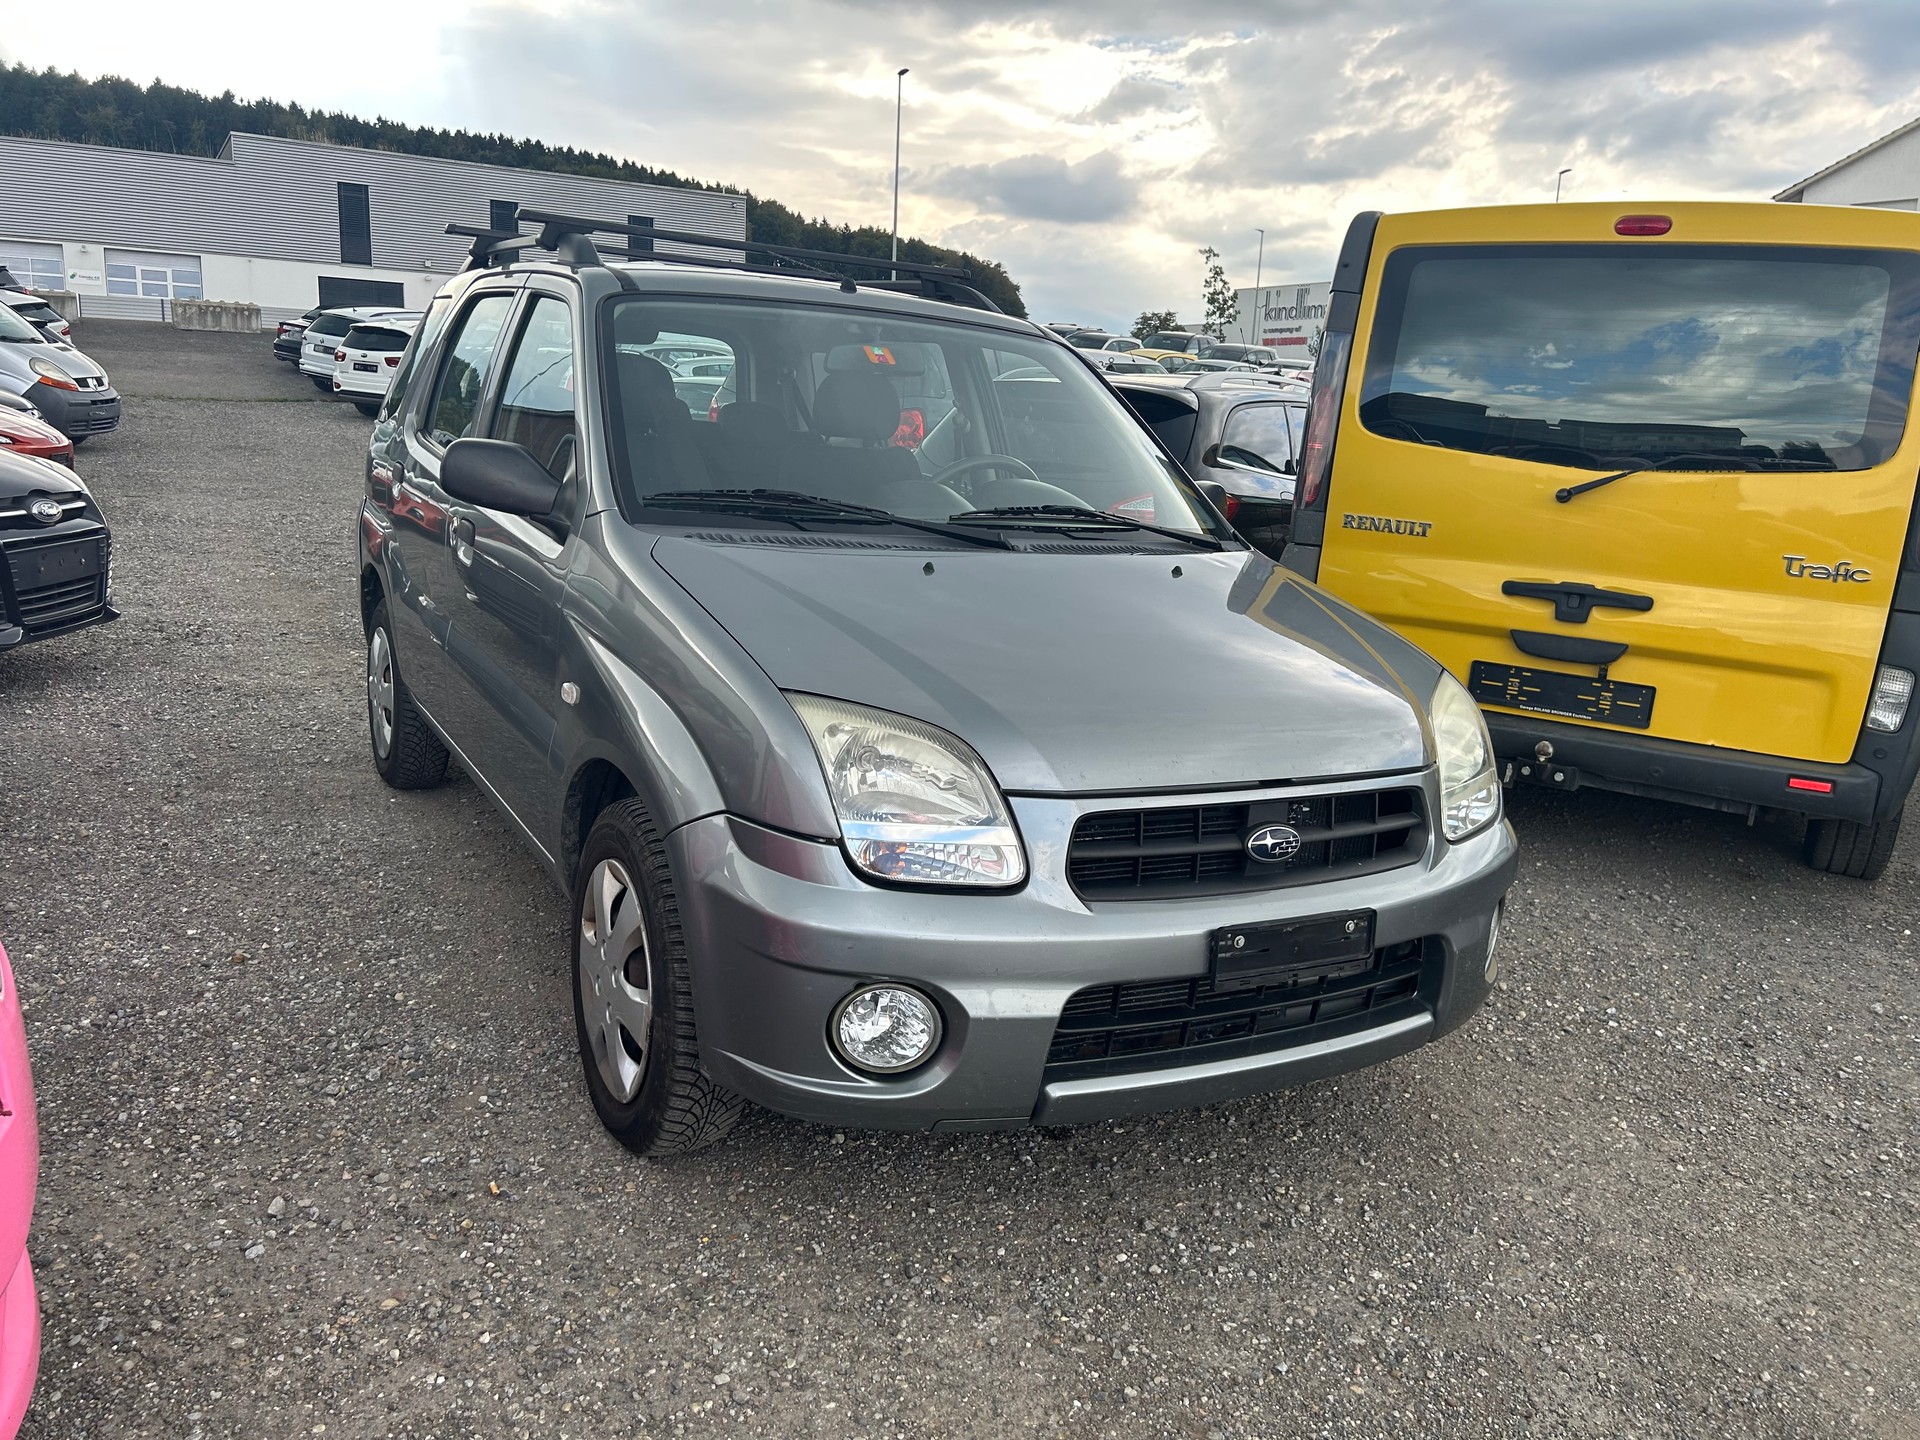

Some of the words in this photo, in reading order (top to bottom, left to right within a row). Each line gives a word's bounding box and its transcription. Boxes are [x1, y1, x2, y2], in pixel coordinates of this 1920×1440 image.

[1264, 288, 1327, 321] kindlim
[1342, 513, 1432, 538] RENAULT
[1782, 553, 1872, 584] Trafic
